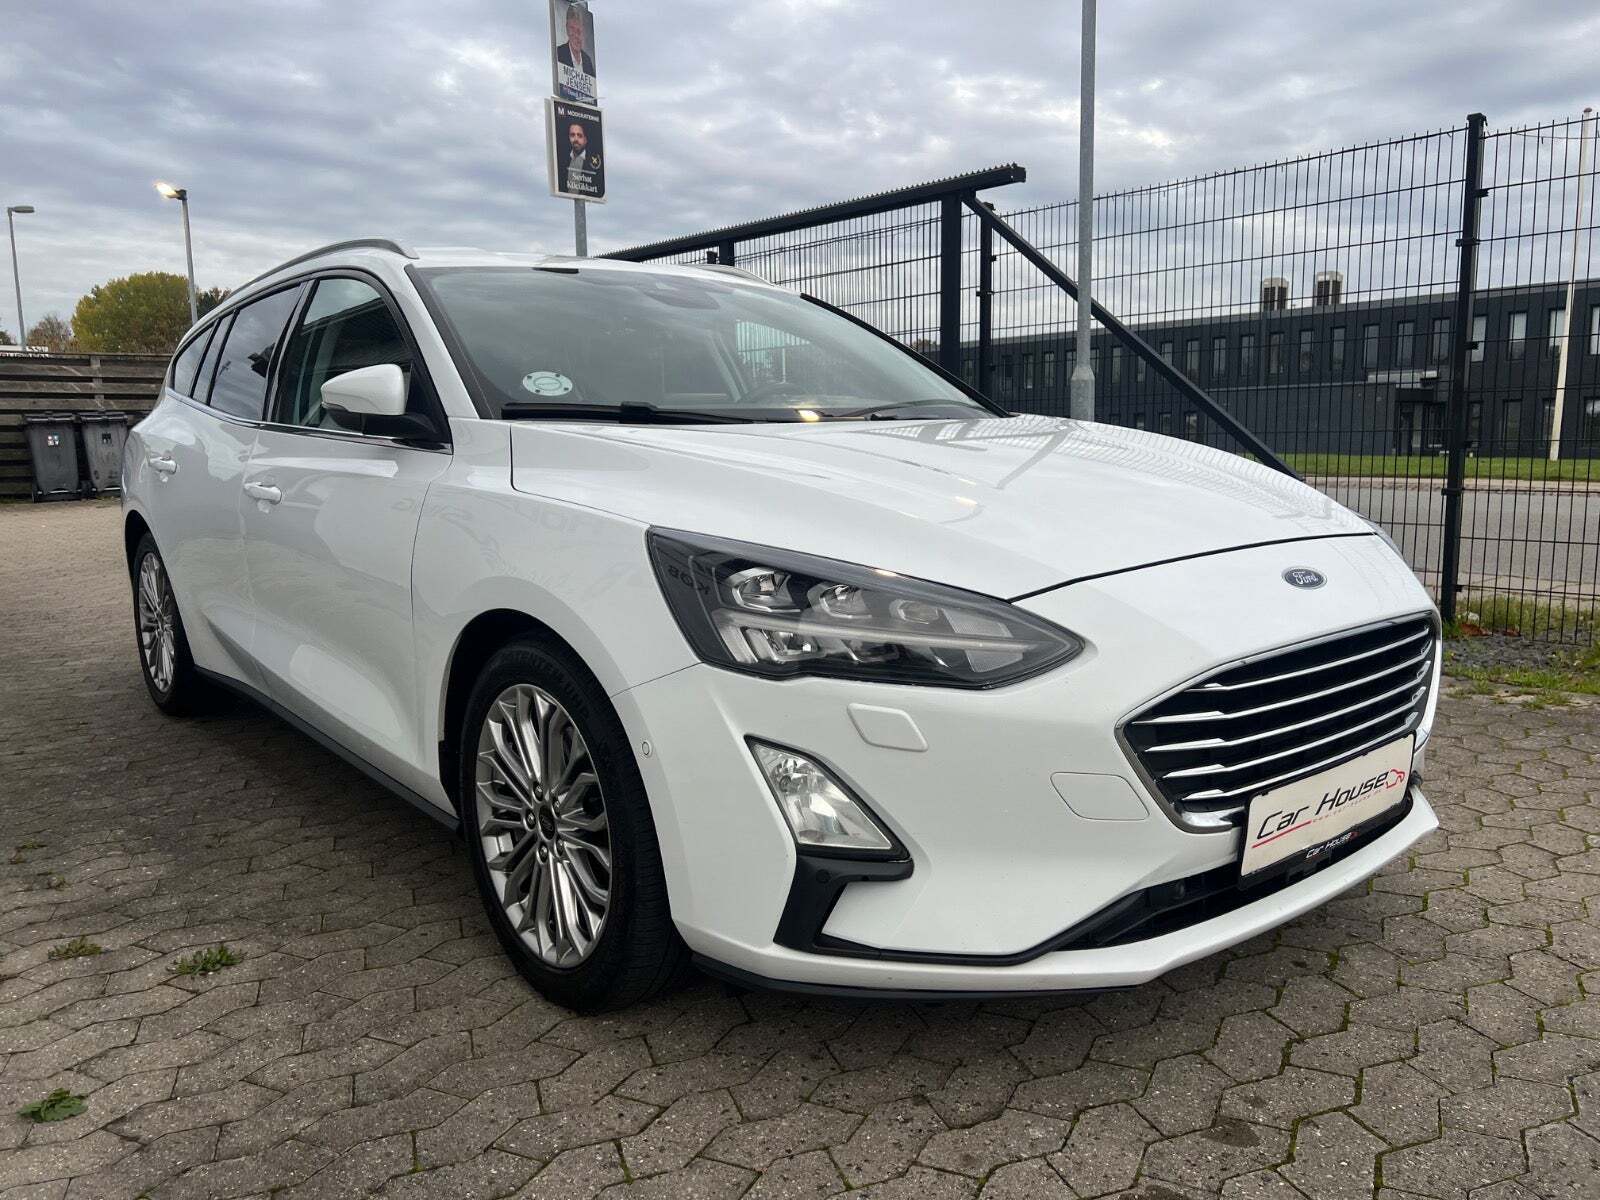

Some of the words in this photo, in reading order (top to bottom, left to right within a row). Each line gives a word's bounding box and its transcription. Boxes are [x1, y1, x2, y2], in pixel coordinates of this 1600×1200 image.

[563, 66, 592, 86] MICHAEL
[566, 77, 591, 94] JENSEN
[1292, 571, 1319, 585] Ford
[1257, 806, 1310, 839] Car
[1305, 845, 1324, 858] Car
